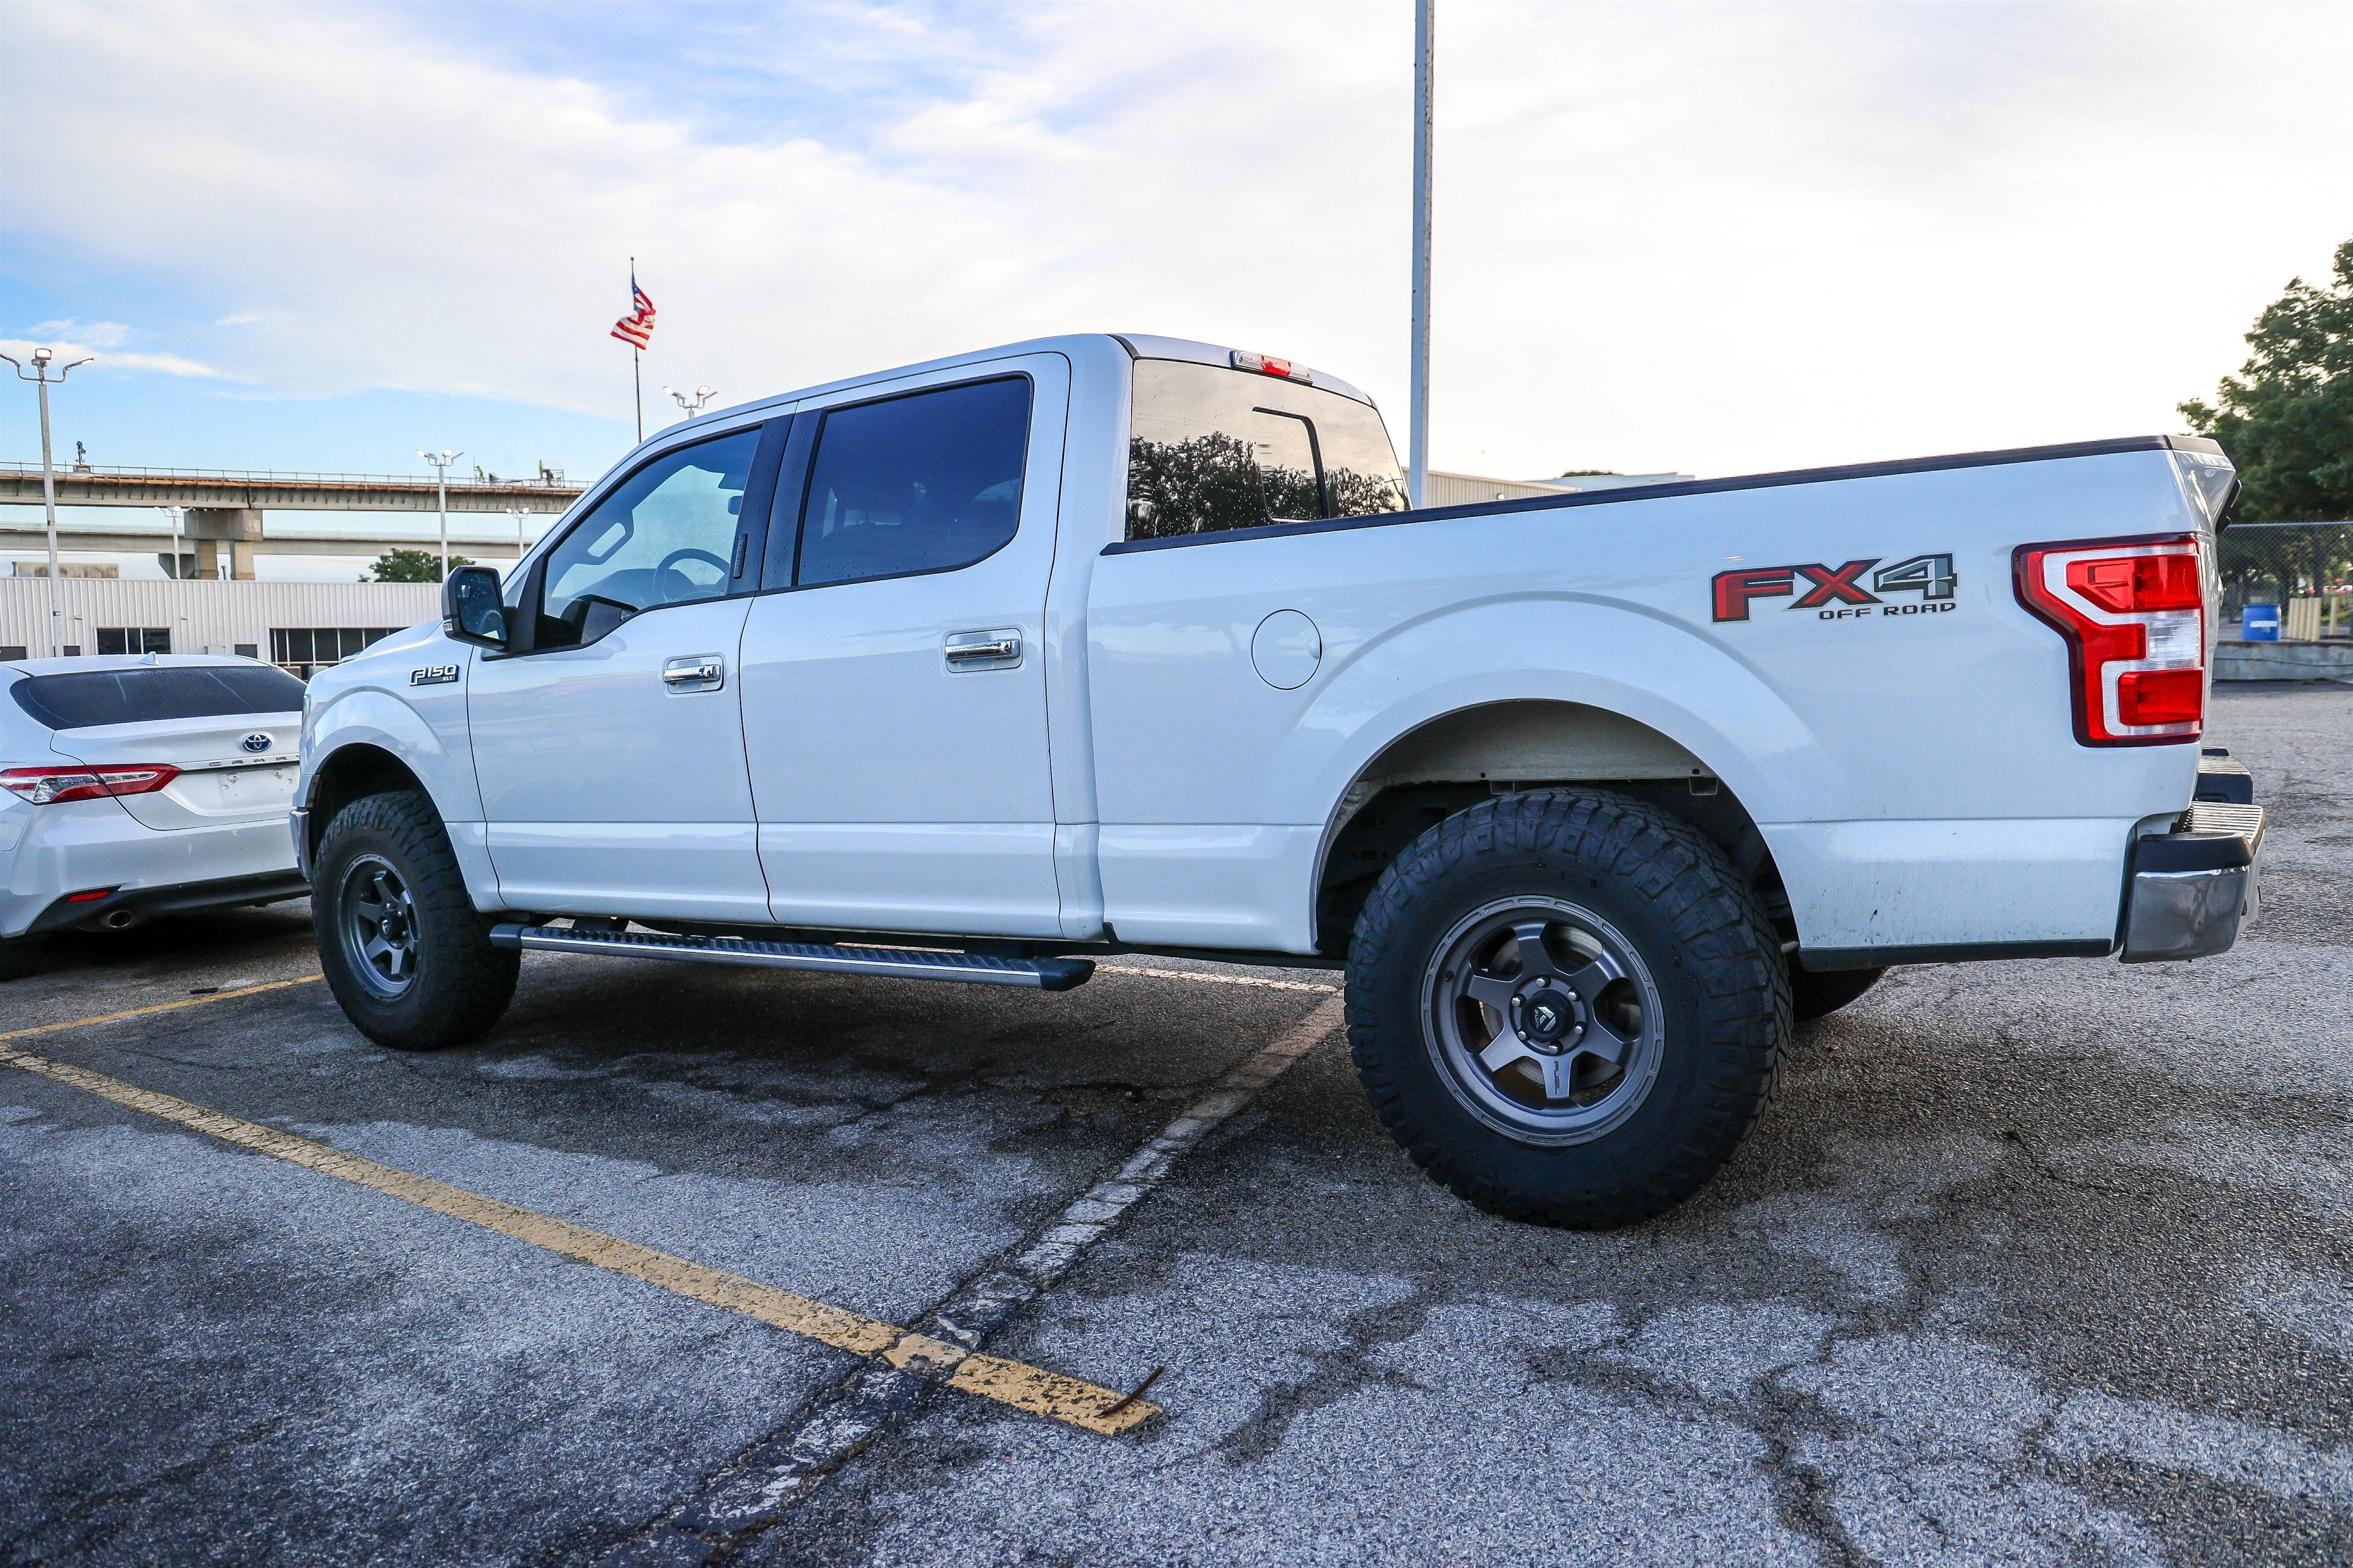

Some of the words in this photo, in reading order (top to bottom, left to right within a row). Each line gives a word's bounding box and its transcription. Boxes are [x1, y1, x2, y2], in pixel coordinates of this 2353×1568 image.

[1711, 553, 1958, 623] FX4
[1819, 608, 1871, 619] OFF
[1884, 603, 1956, 616] ROAD
